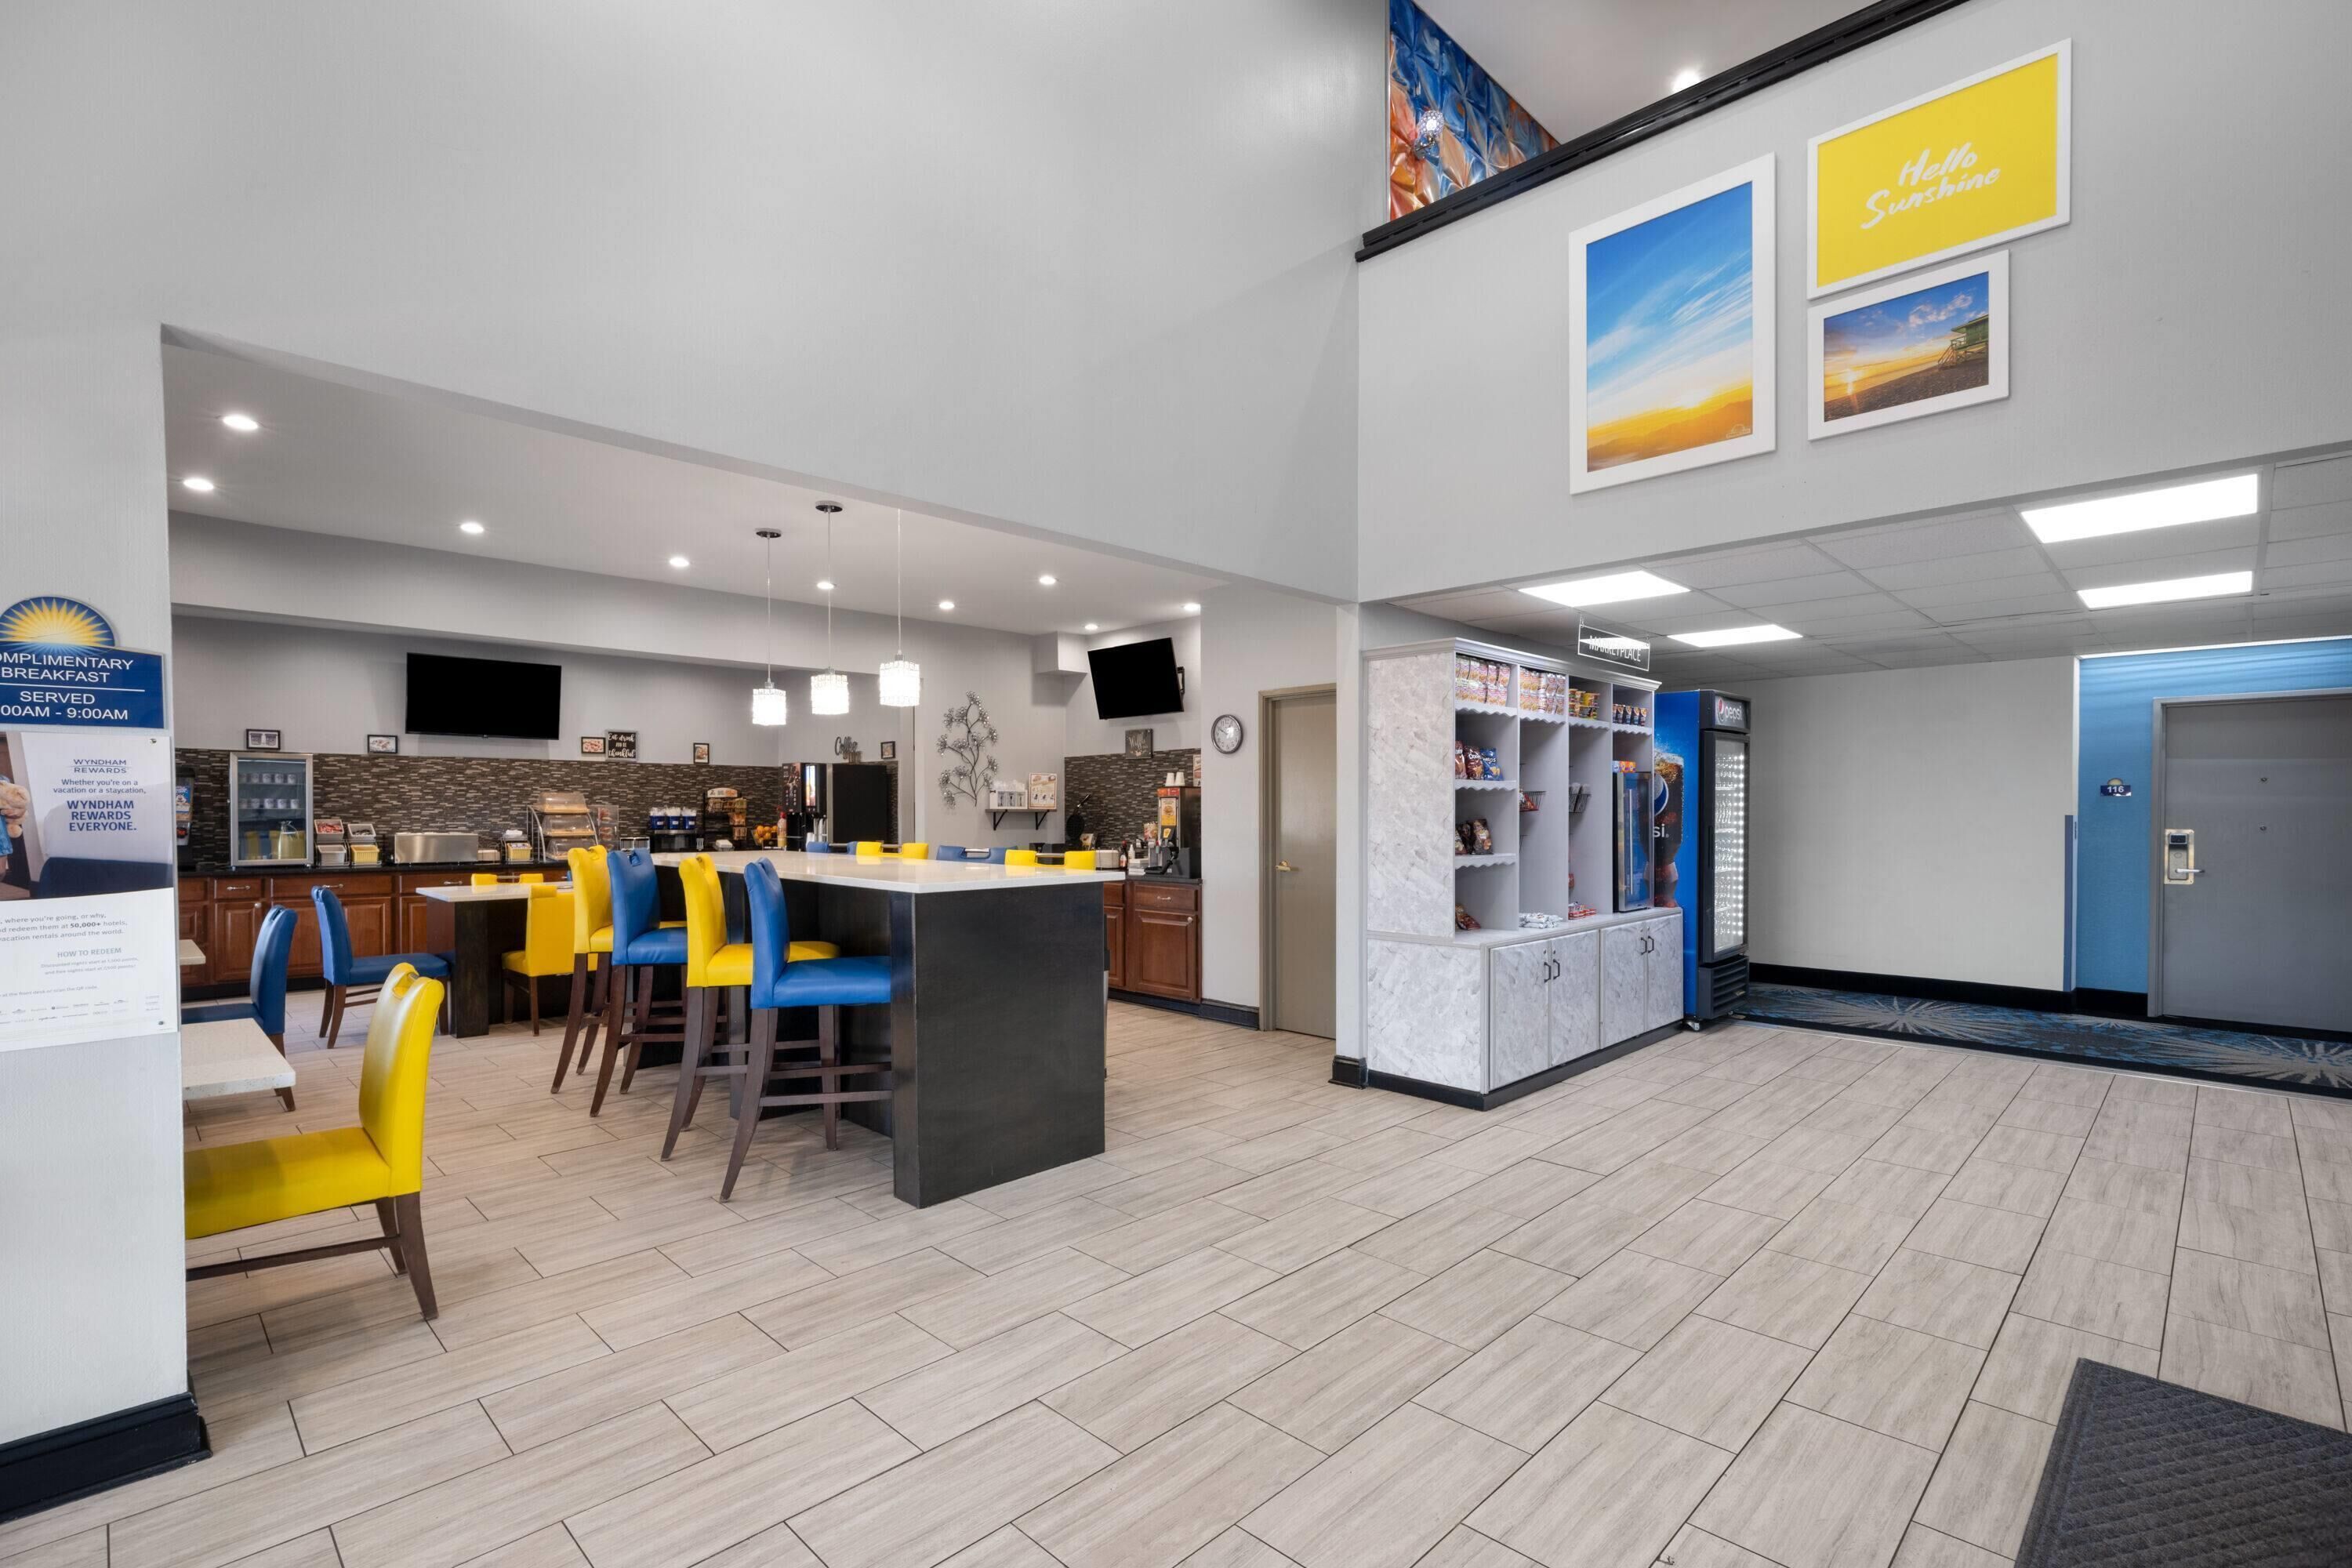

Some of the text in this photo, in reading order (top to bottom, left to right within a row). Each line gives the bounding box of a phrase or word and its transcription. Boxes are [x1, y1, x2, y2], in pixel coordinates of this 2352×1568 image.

[1897, 141, 1978, 187] Hello
[1860, 168, 2001, 229] Sunshine
[1588, 635, 1642, 662] MARKETPLACE
[0, 652, 134, 670] MPLIMENTARY
[2, 667, 111, 684] BREAKFAST
[20, 691, 96, 705] SERVED
[67, 707, 129, 720] 9:00AM
[1725, 706, 1742, 723] pepsi
[67, 800, 134, 810] WYNDHAM
[71, 811, 131, 821] REWARDS
[69, 822, 137, 832] EVERYONE.
[89, 913, 107, 921] why,
[90, 947, 122, 956] REDEEM
